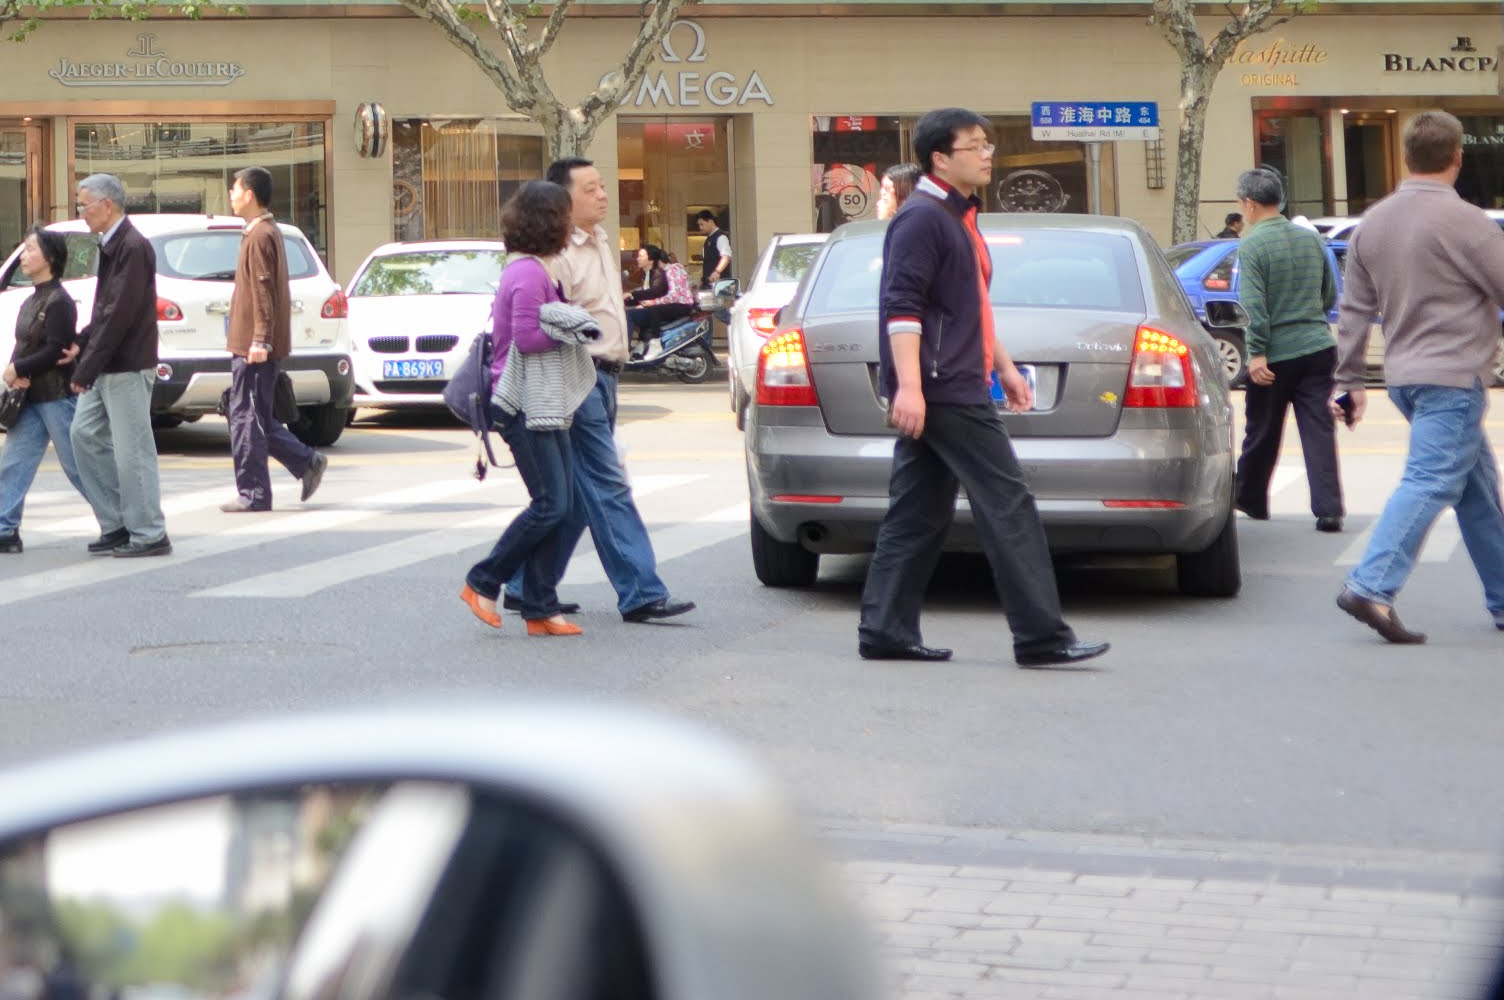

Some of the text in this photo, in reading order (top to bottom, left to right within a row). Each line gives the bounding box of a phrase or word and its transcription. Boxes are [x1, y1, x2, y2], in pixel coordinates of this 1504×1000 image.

[1241, 73, 1300, 86] ORIGINAL
[1060, 106, 1131, 124] 淮海中路
[1041, 130, 1051, 138] W
[844, 194, 861, 205] 50
